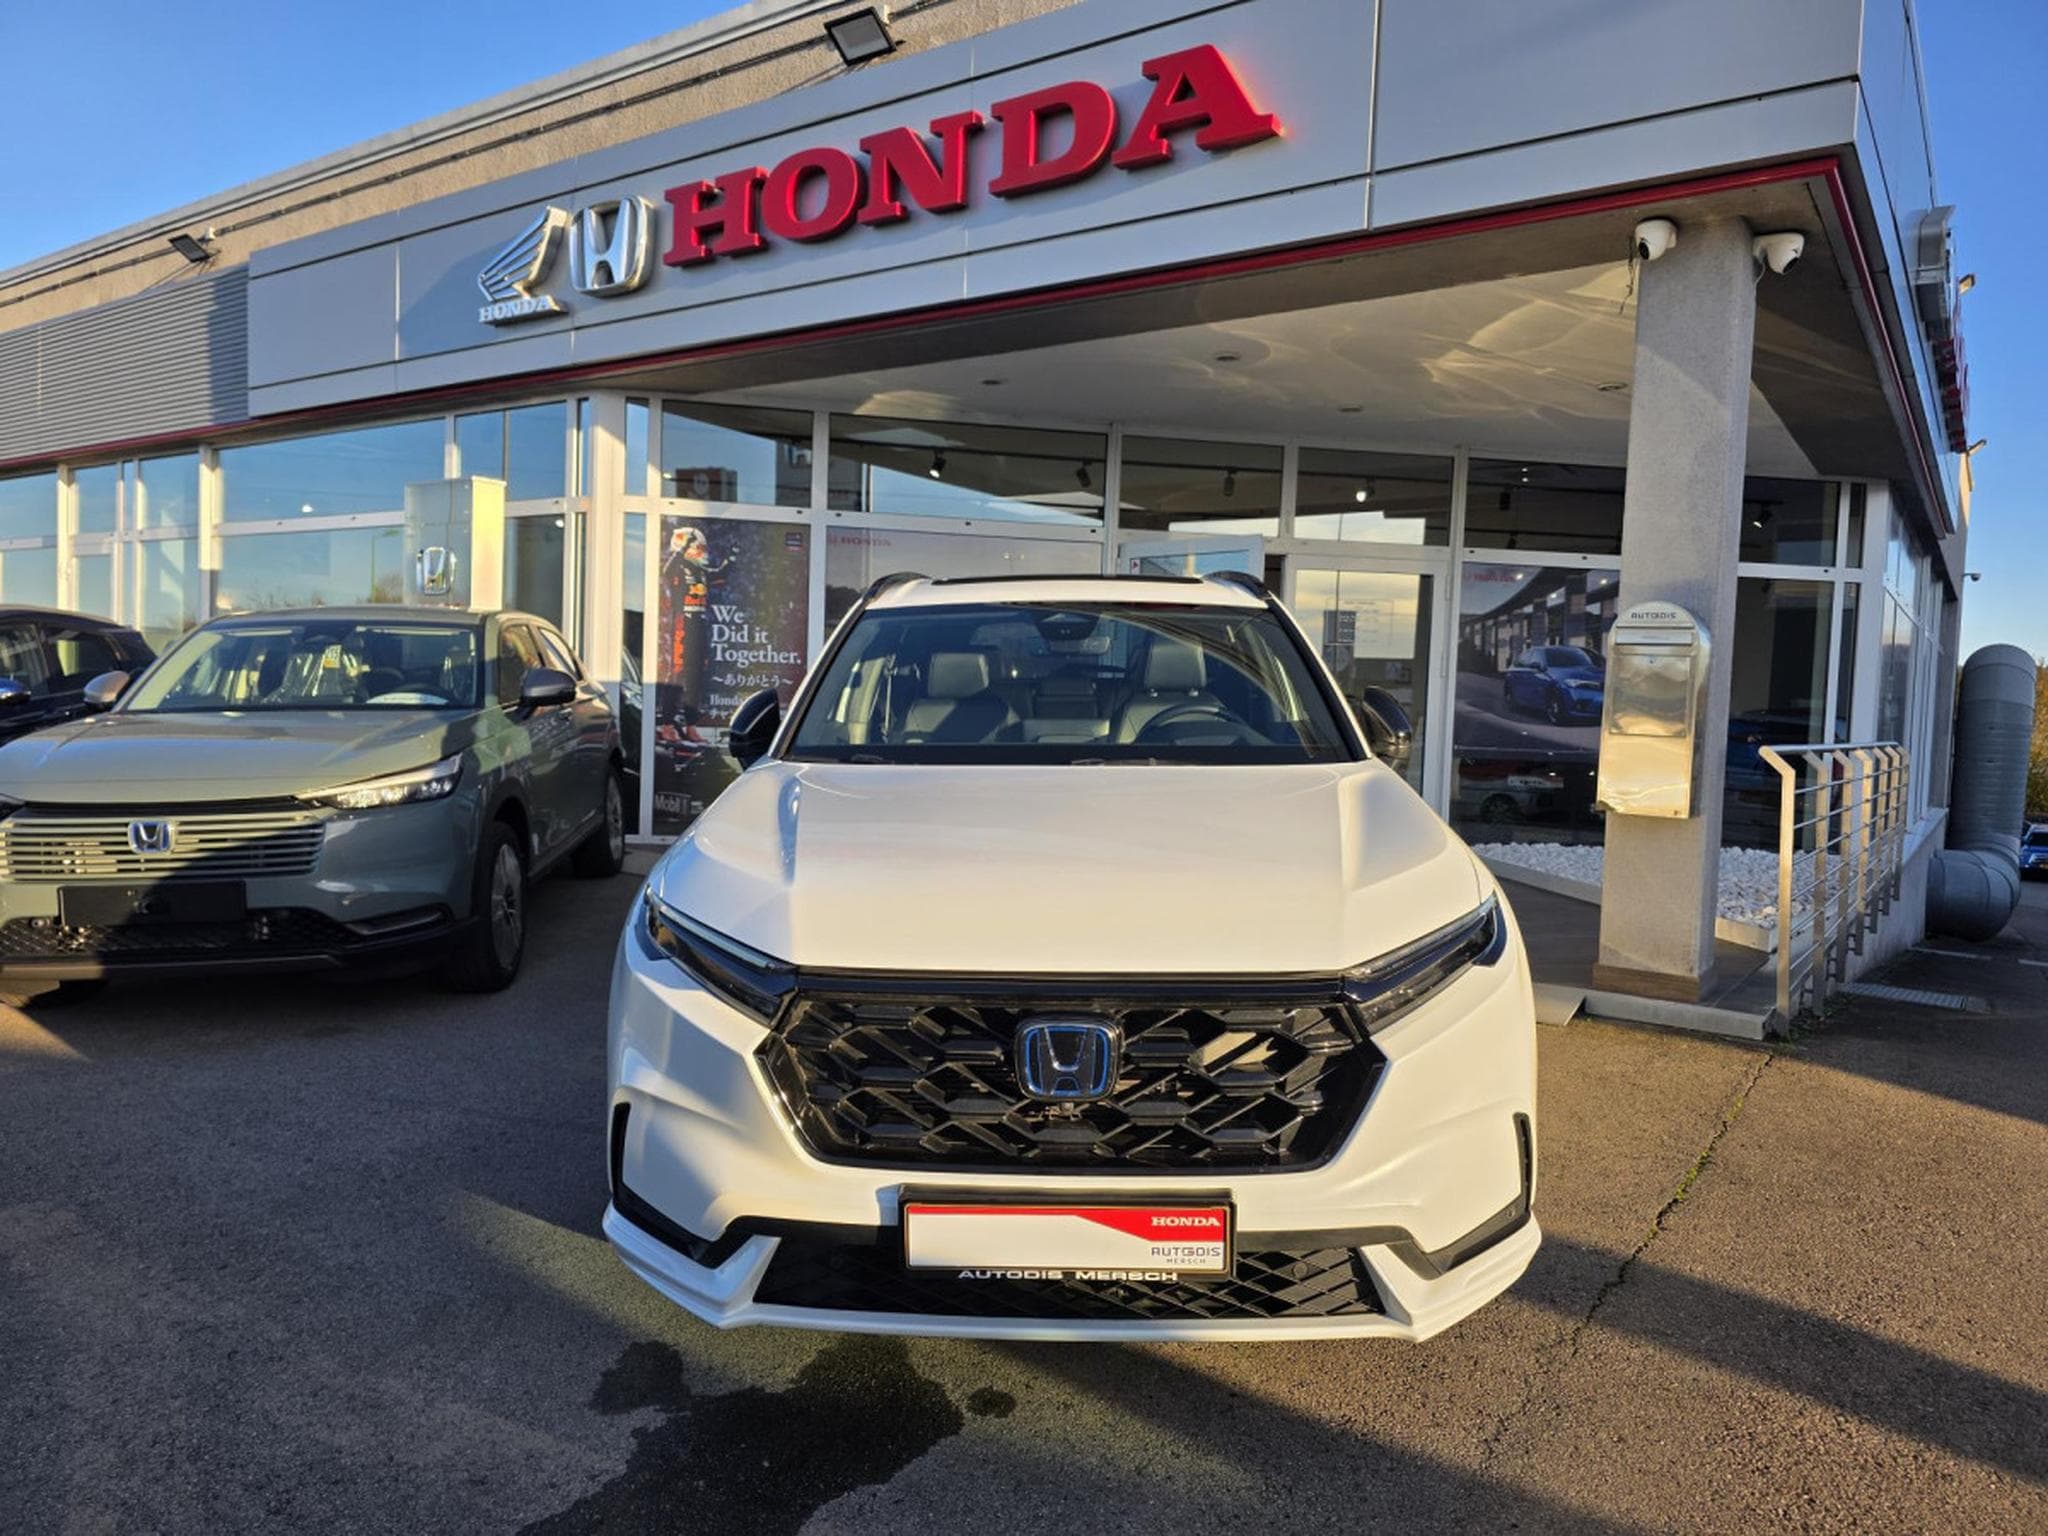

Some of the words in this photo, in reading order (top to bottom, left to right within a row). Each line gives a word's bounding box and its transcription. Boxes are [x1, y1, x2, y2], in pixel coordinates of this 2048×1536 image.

[663, 44, 1285, 268] HONDA
[478, 295, 562, 322] HONDA
[711, 604, 745, 623] We
[711, 624, 749, 643] Did
[754, 627, 769, 643] it
[711, 643, 801, 668] Together.
[1151, 1216, 1221, 1227] HONDA
[958, 1270, 1063, 1280] AUTODIS
[1075, 1271, 1178, 1282] MERSCH
